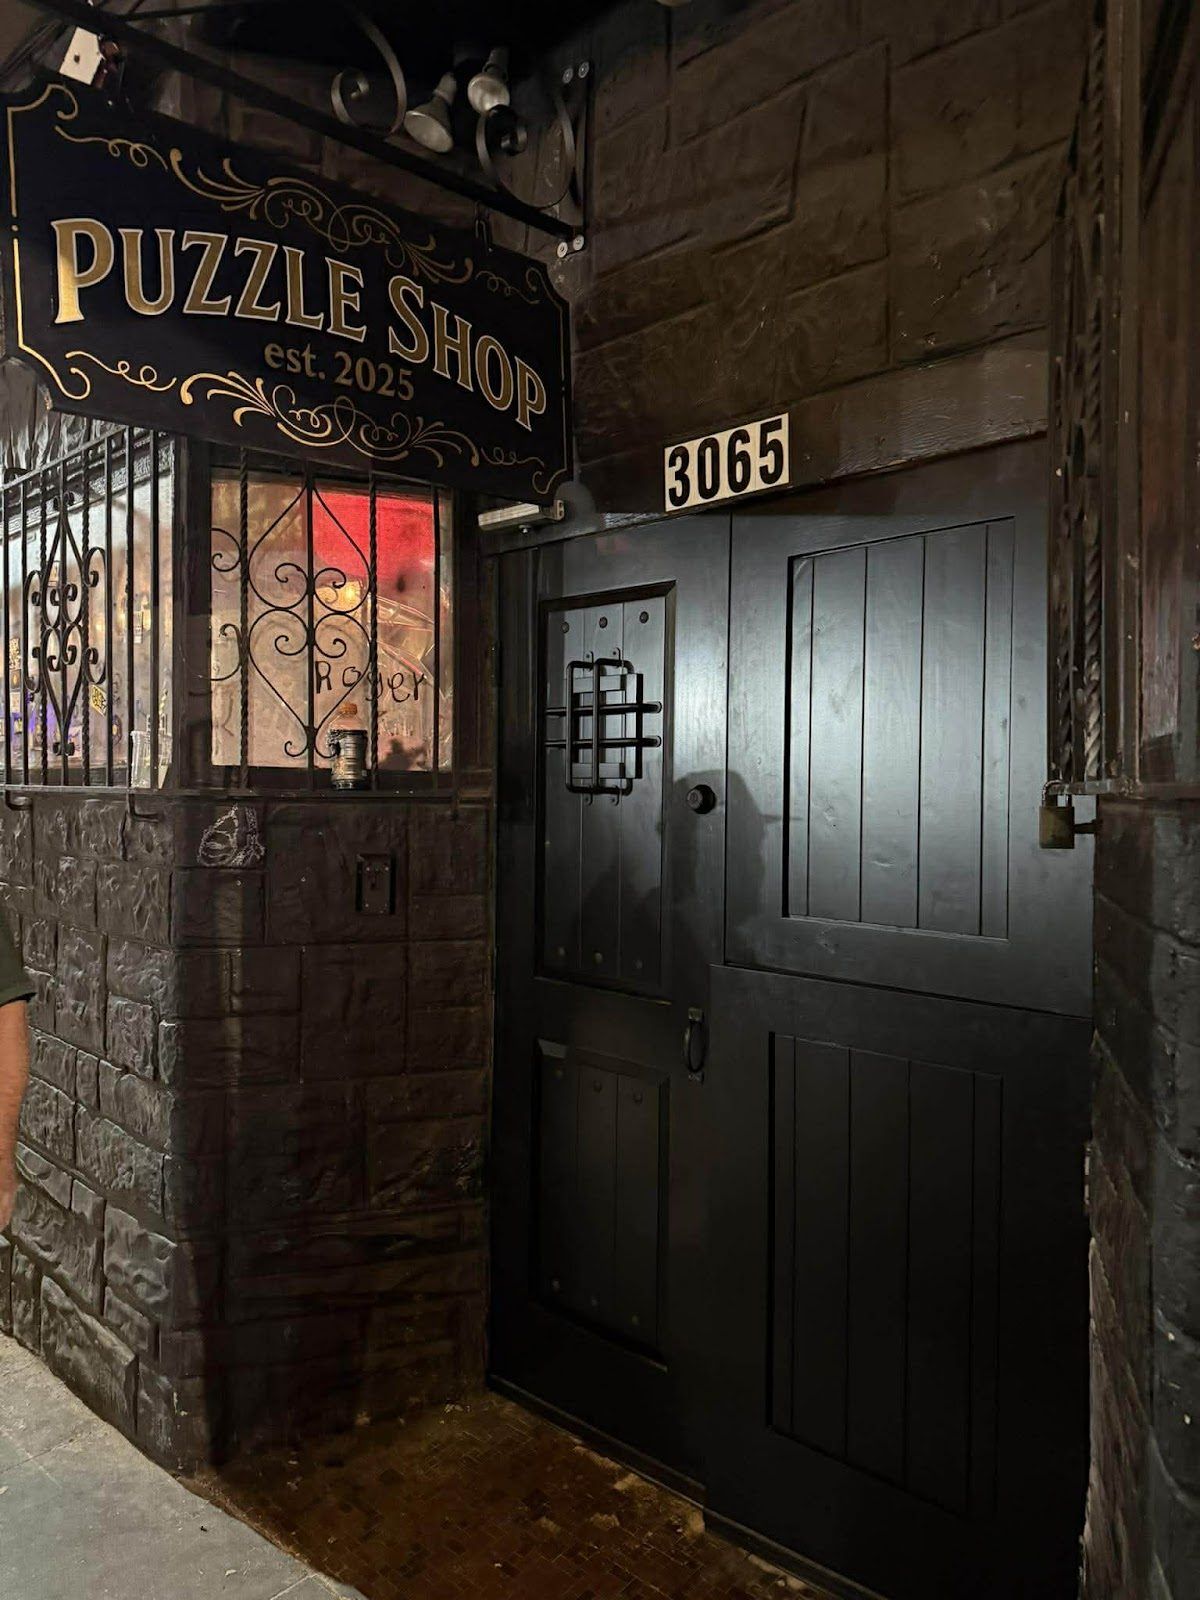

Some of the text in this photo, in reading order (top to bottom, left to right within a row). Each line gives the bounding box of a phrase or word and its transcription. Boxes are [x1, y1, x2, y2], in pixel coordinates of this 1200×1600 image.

[51, 218, 547, 431] PUZZLE SHOP
[264, 342, 415, 402] est. 2025
[668, 419, 784, 507] 3065
